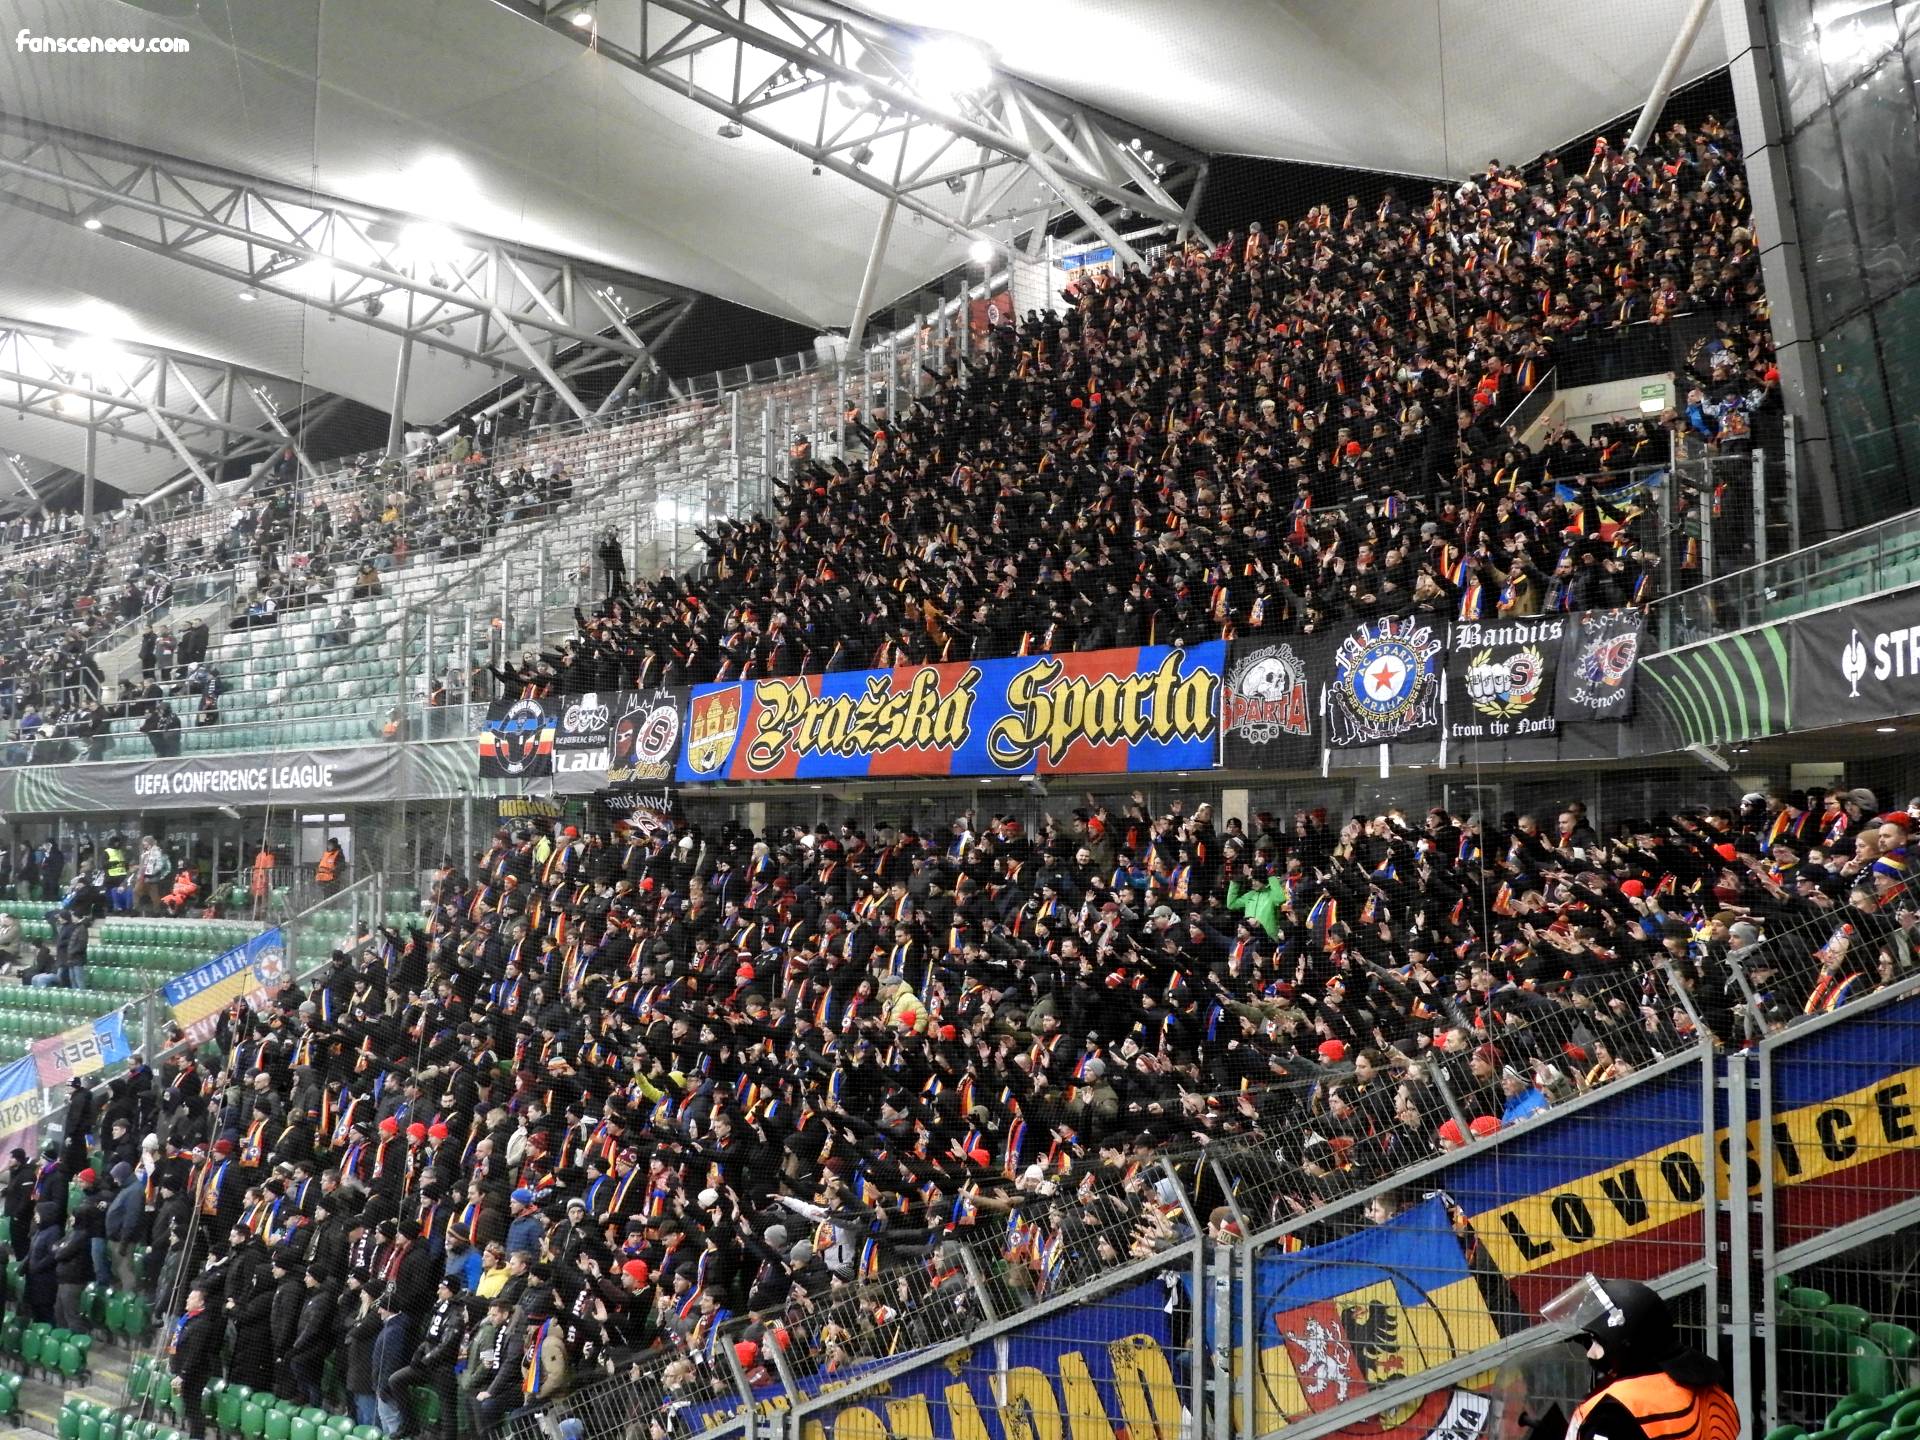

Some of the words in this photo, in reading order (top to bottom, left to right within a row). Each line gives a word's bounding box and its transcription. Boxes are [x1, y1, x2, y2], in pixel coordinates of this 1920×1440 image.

[1455, 618, 1565, 653] Bandits
[1357, 656, 1373, 678] AC
[1375, 645, 1416, 672] SPARTA
[745, 665, 983, 773] Pražská
[987, 649, 1220, 770] Sparta
[1222, 678, 1312, 737] SPARTA
[1363, 694, 1406, 713] PRAHA
[1452, 722, 1483, 738] from
[1490, 720, 1509, 738] the
[1515, 715, 1555, 735] North
[134, 772, 171, 795] UEFA
[173, 768, 267, 793] CONFERENCE
[271, 764, 333, 789] LEAGUE
[1500, 1081, 1918, 1262] LOVOSICE
